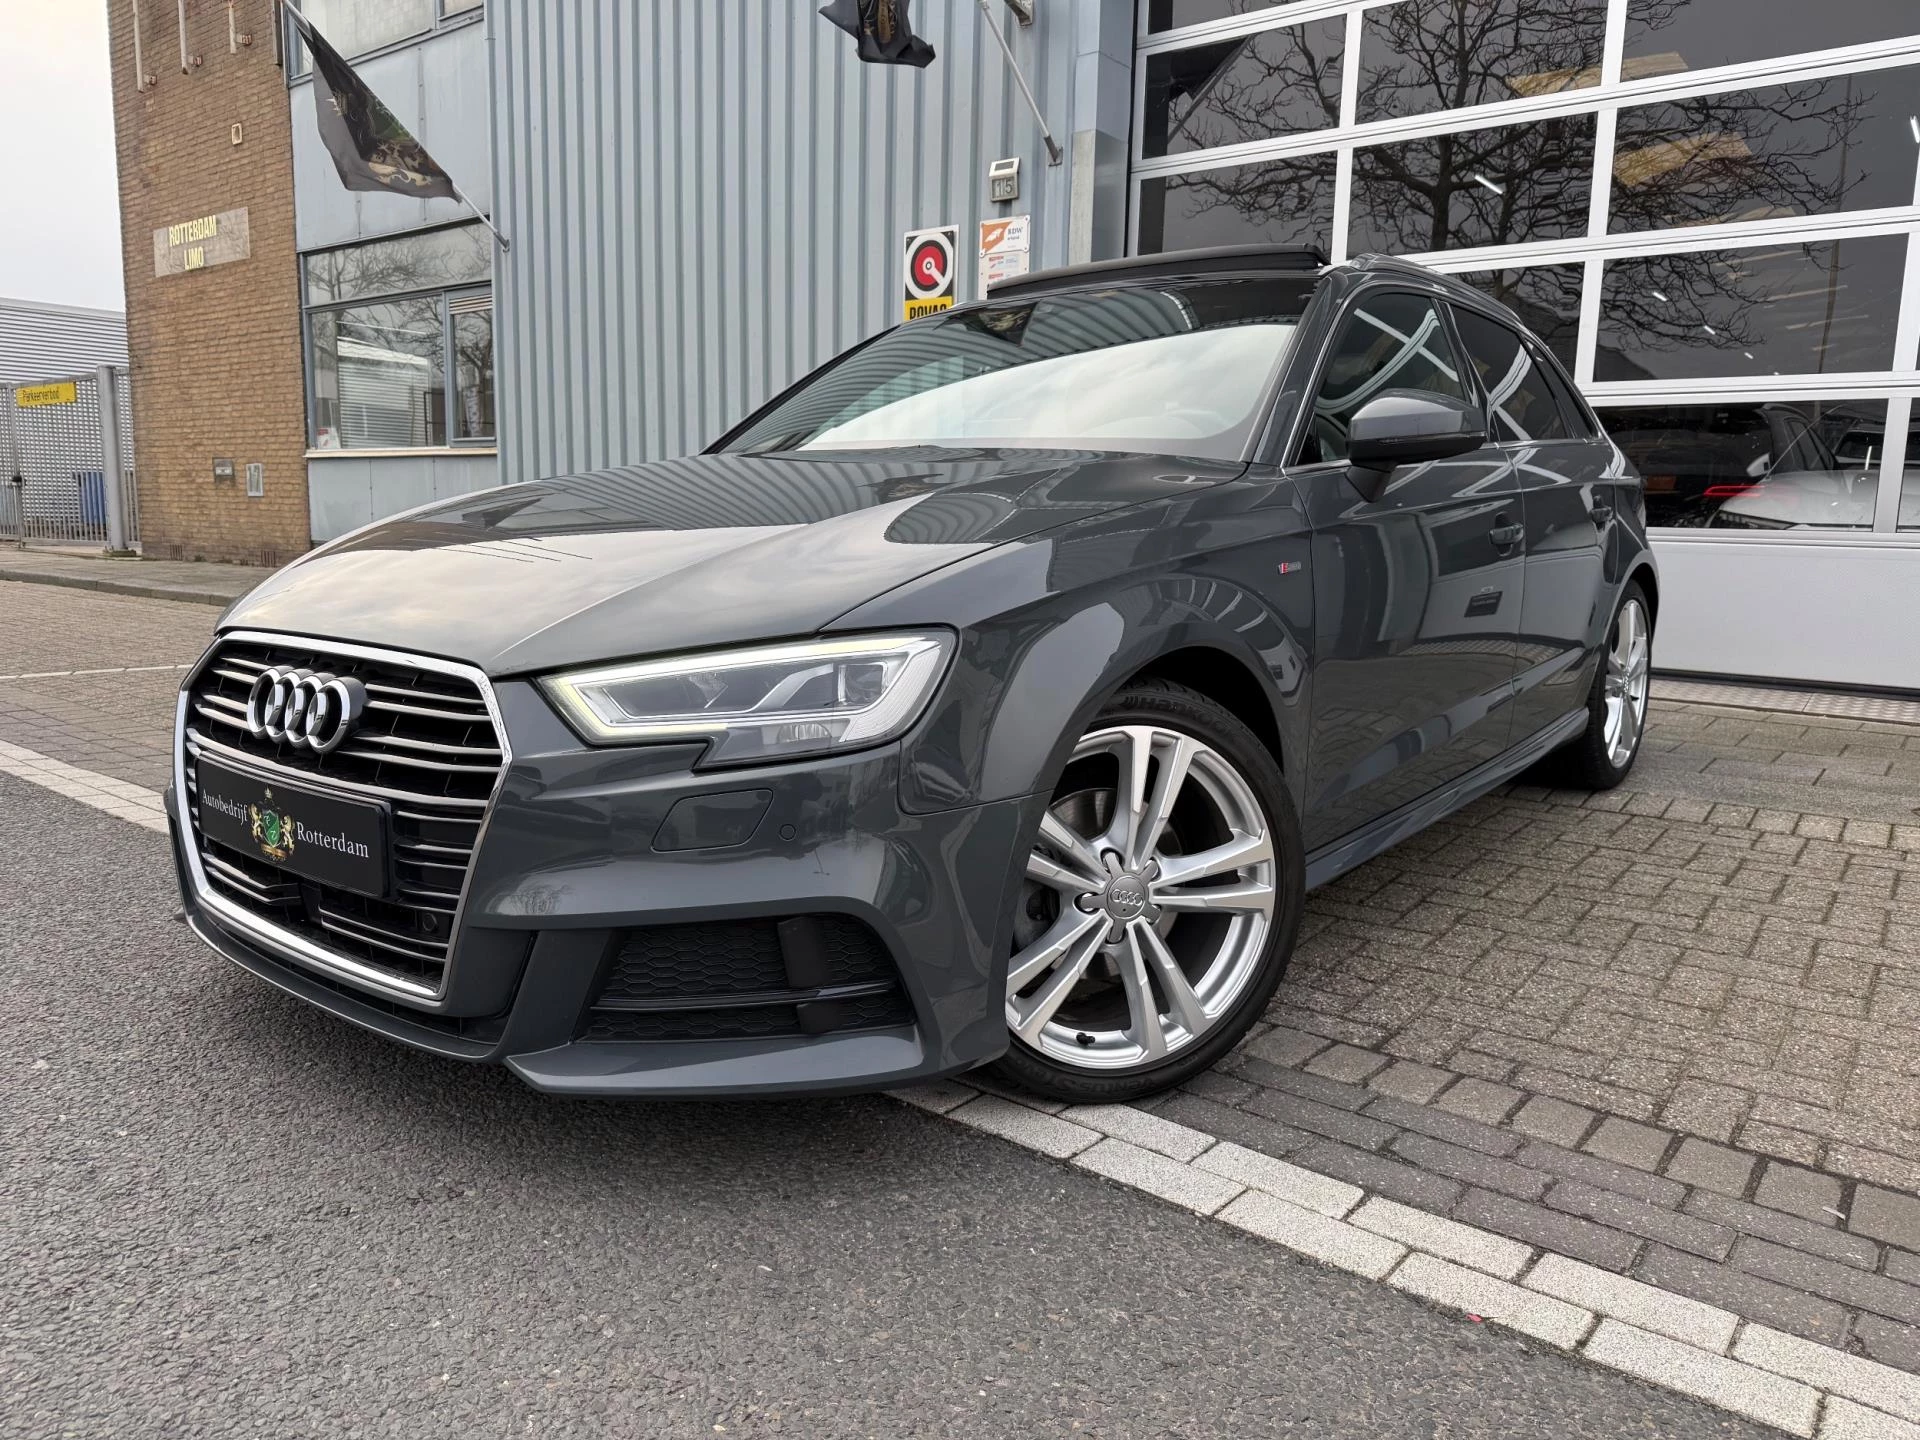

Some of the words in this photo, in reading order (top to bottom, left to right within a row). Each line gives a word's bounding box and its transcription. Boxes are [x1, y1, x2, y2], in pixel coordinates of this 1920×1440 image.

[995, 177, 1013, 197] 15
[168, 214, 217, 248] ROTTERDAM
[183, 246, 205, 271] LIMO
[22, 385, 60, 404] Parkeerverbod
[202, 788, 249, 826] Autobedrijf
[296, 821, 370, 859] Rotterdam
